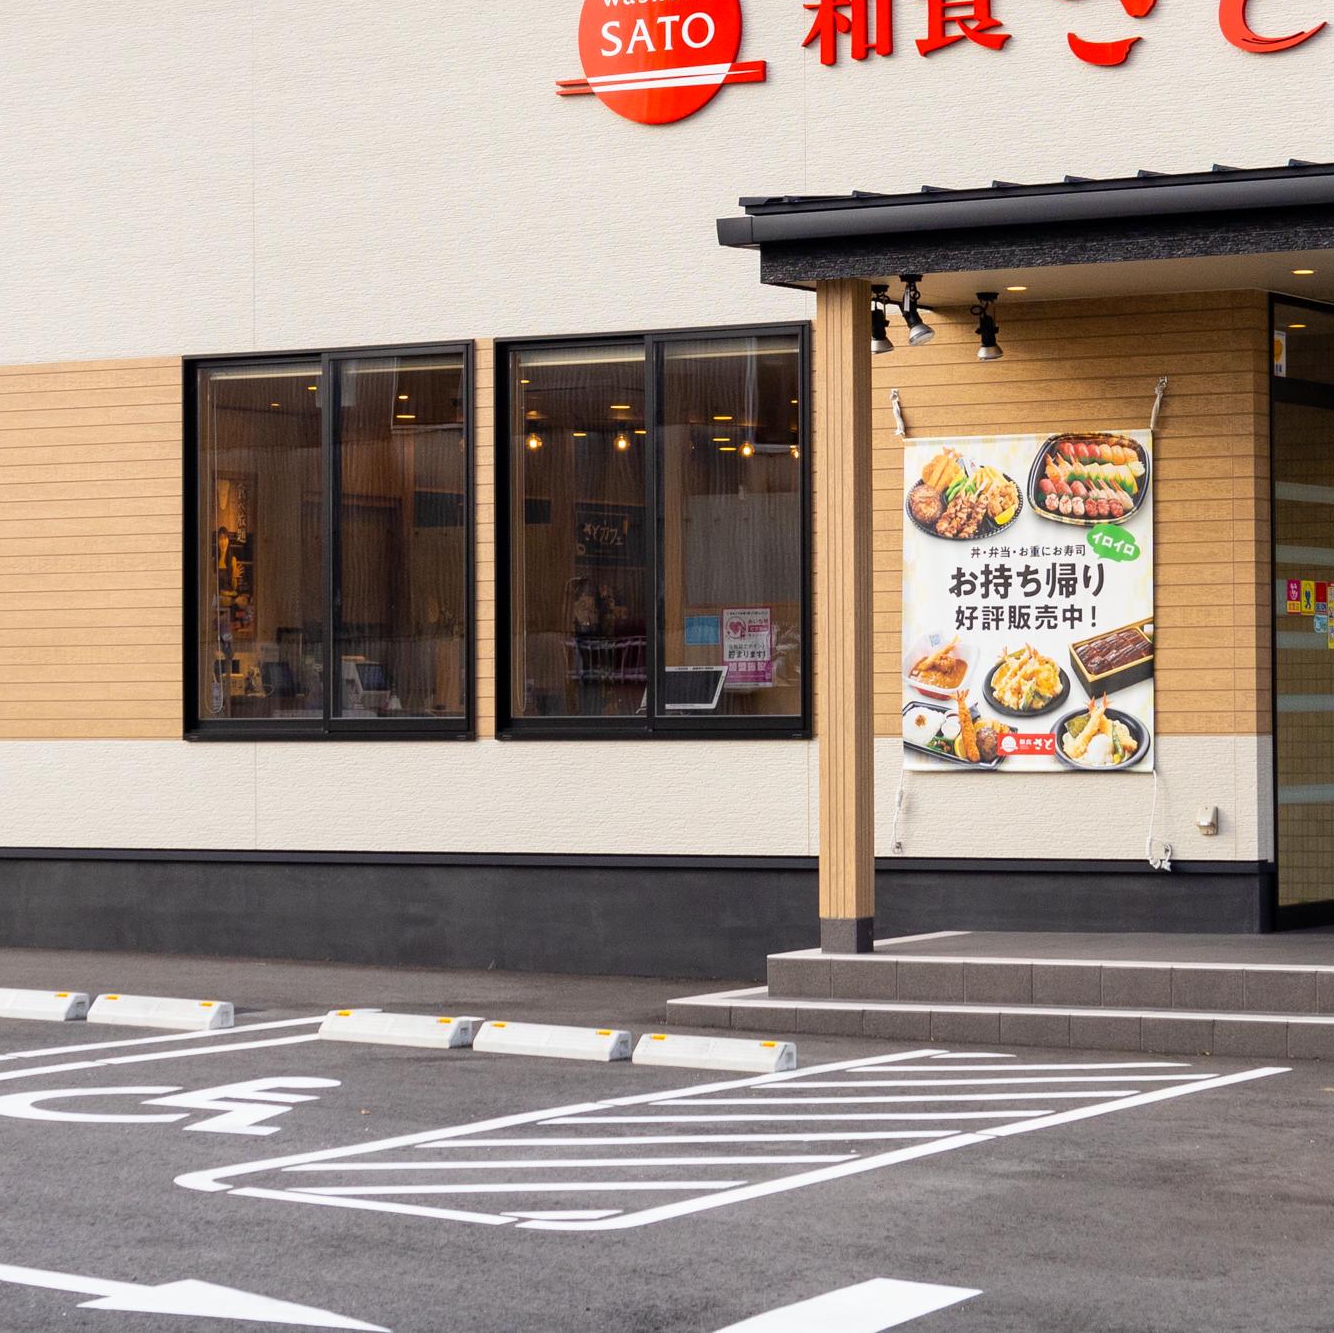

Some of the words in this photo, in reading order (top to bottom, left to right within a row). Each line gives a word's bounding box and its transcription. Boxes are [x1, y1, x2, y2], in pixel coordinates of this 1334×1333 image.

[600, 12, 716, 57] SATO
[1091, 530, 1136, 556] イロイロ
[948, 562, 1105, 599] お持ち帰り
